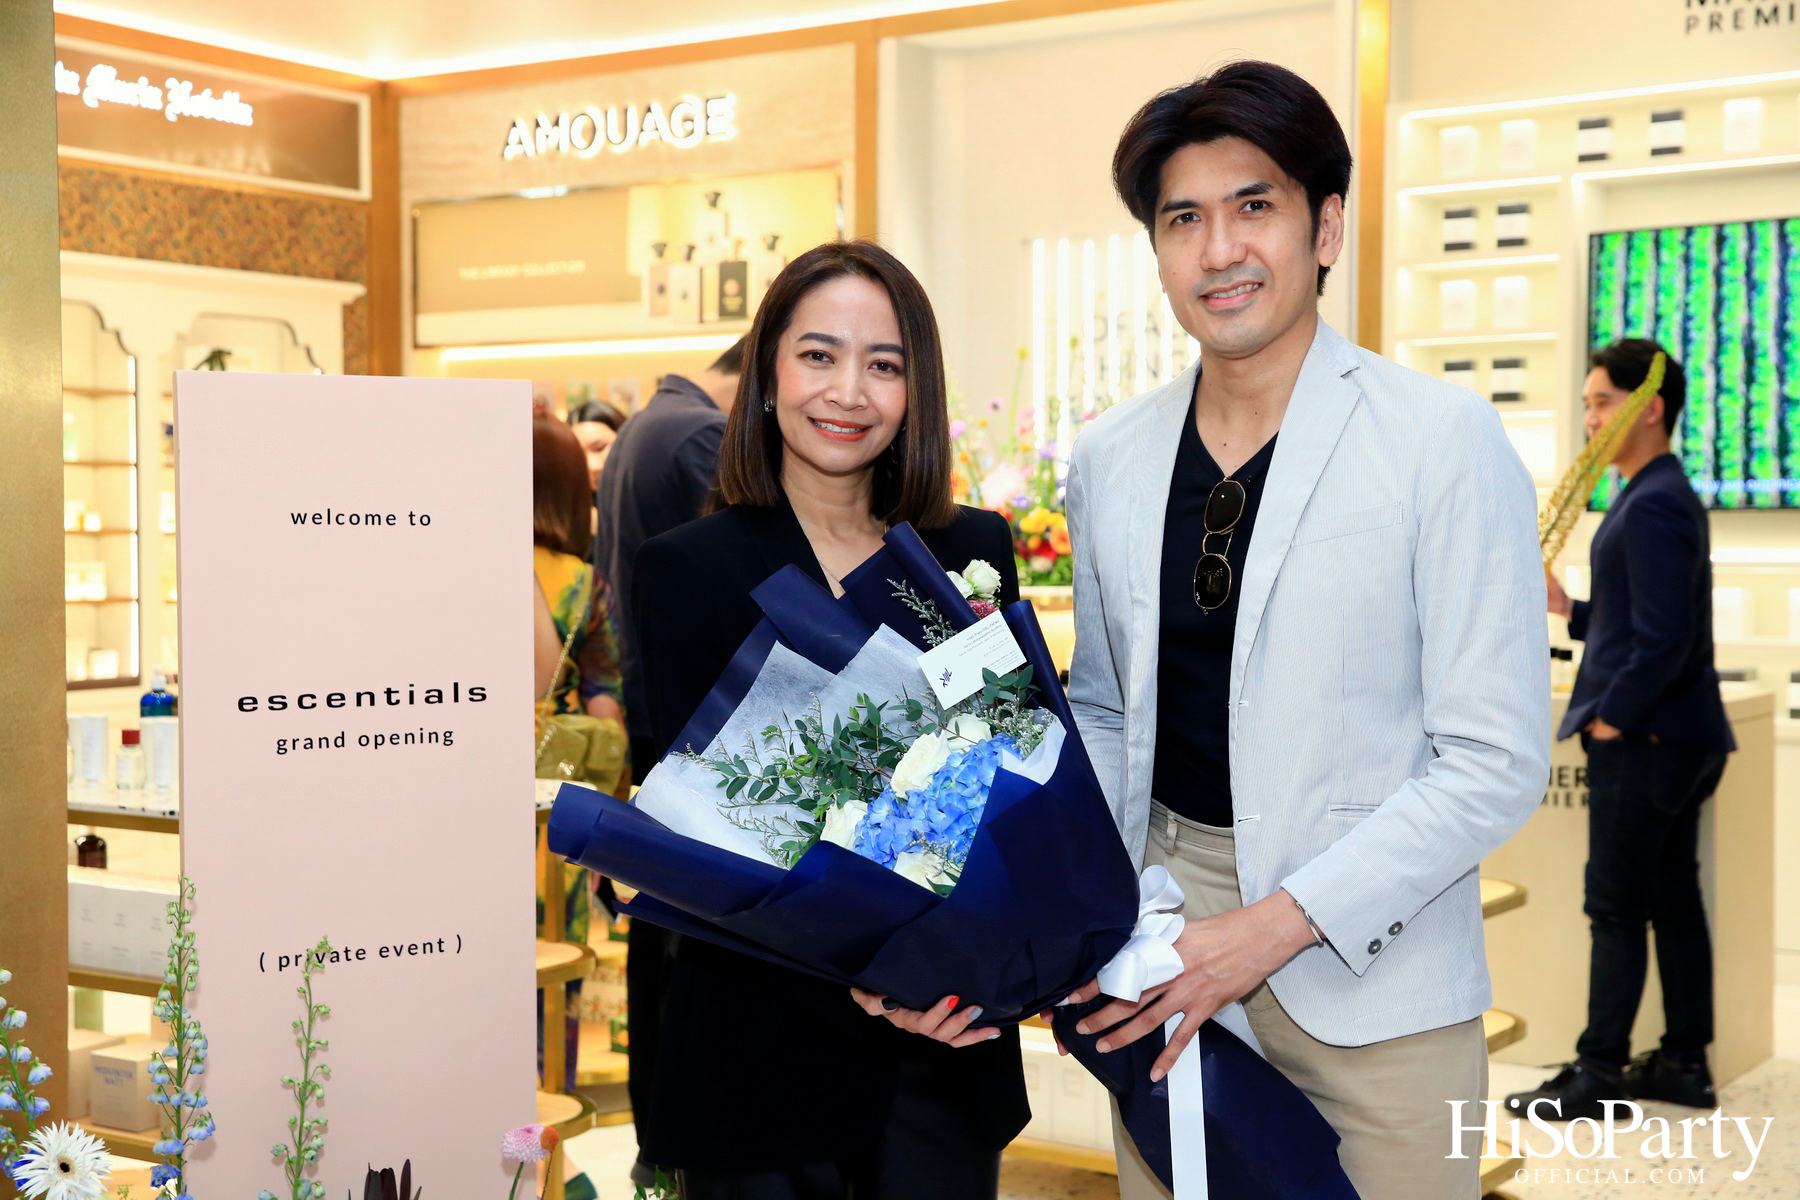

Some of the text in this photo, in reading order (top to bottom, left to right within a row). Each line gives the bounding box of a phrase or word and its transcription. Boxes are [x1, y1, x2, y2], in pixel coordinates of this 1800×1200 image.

[502, 93, 737, 161] AMOUAGE
[290, 508, 432, 526] welcome to
[237, 682, 487, 713] escentials
[276, 728, 454, 755] grand opening
[378, 938, 445, 959] event
